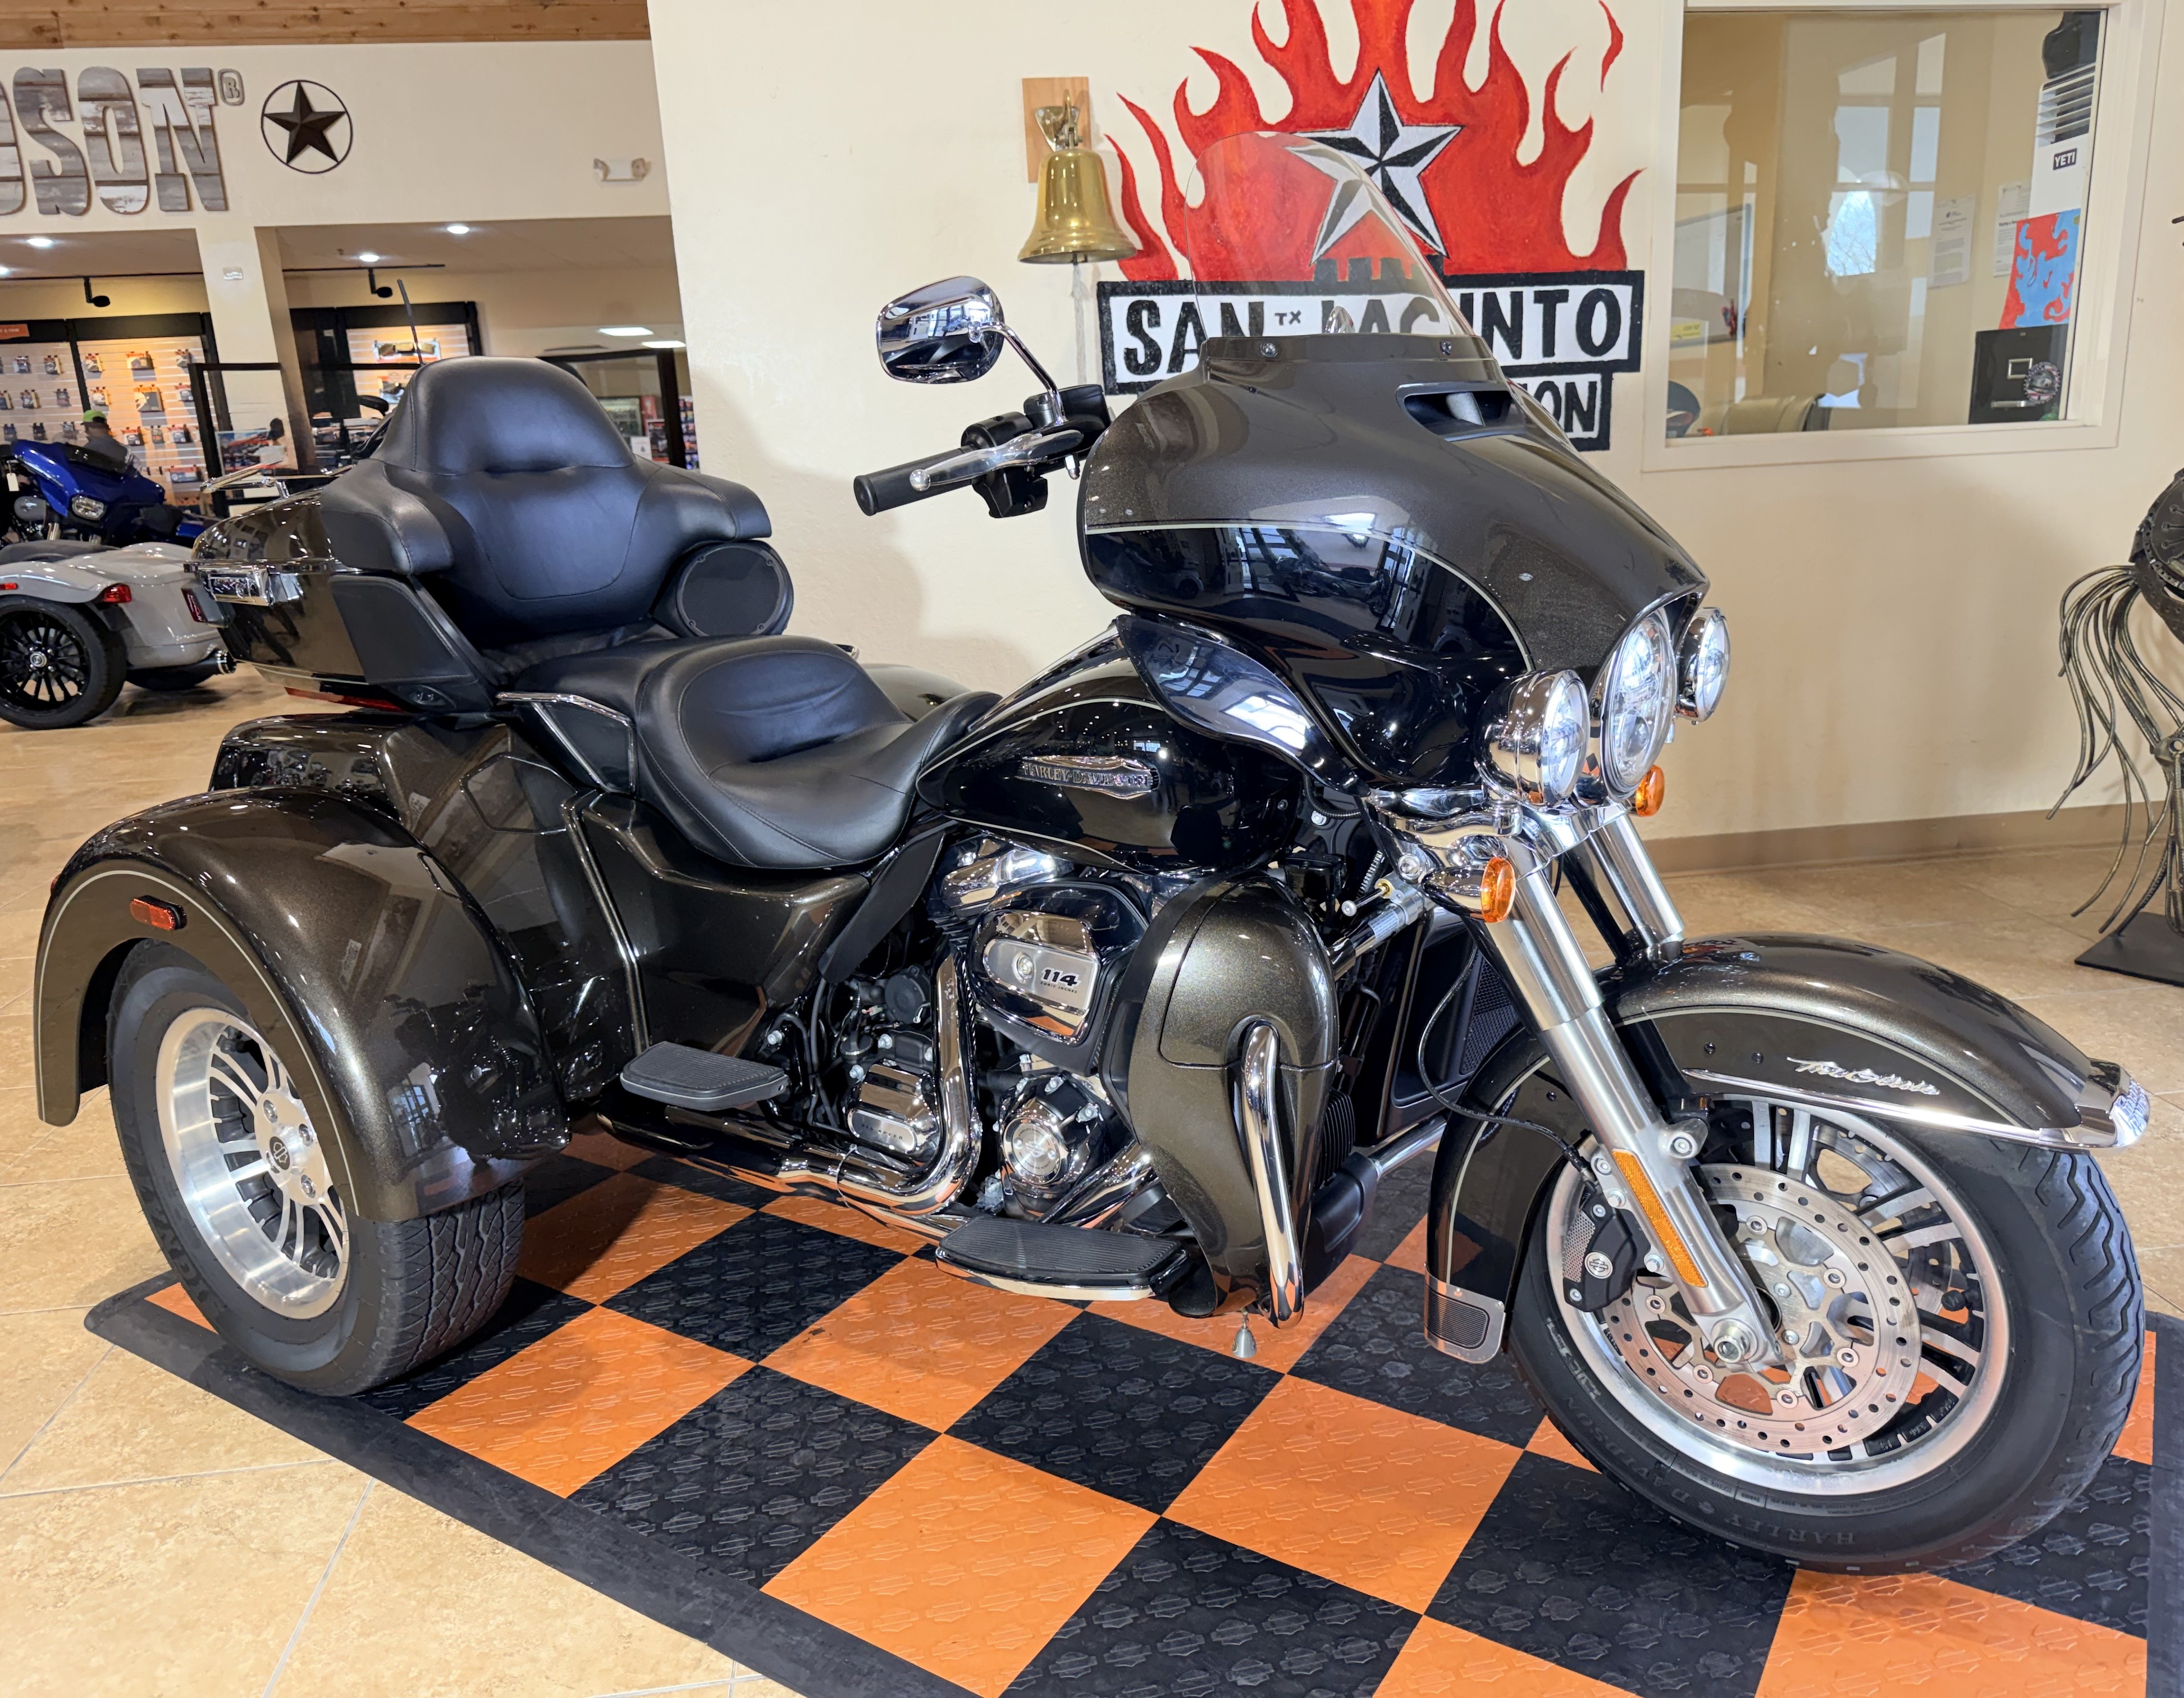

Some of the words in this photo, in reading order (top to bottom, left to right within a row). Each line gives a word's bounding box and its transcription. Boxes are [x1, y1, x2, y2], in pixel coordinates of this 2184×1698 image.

[2055, 151, 2076, 167] YETI
[1274, 309, 1301, 327] TX
[1023, 761, 1149, 787] HARLEY-DAVIDSON
[1043, 968, 1079, 987] 114
[1724, 1514, 1856, 1545] HARLEY
